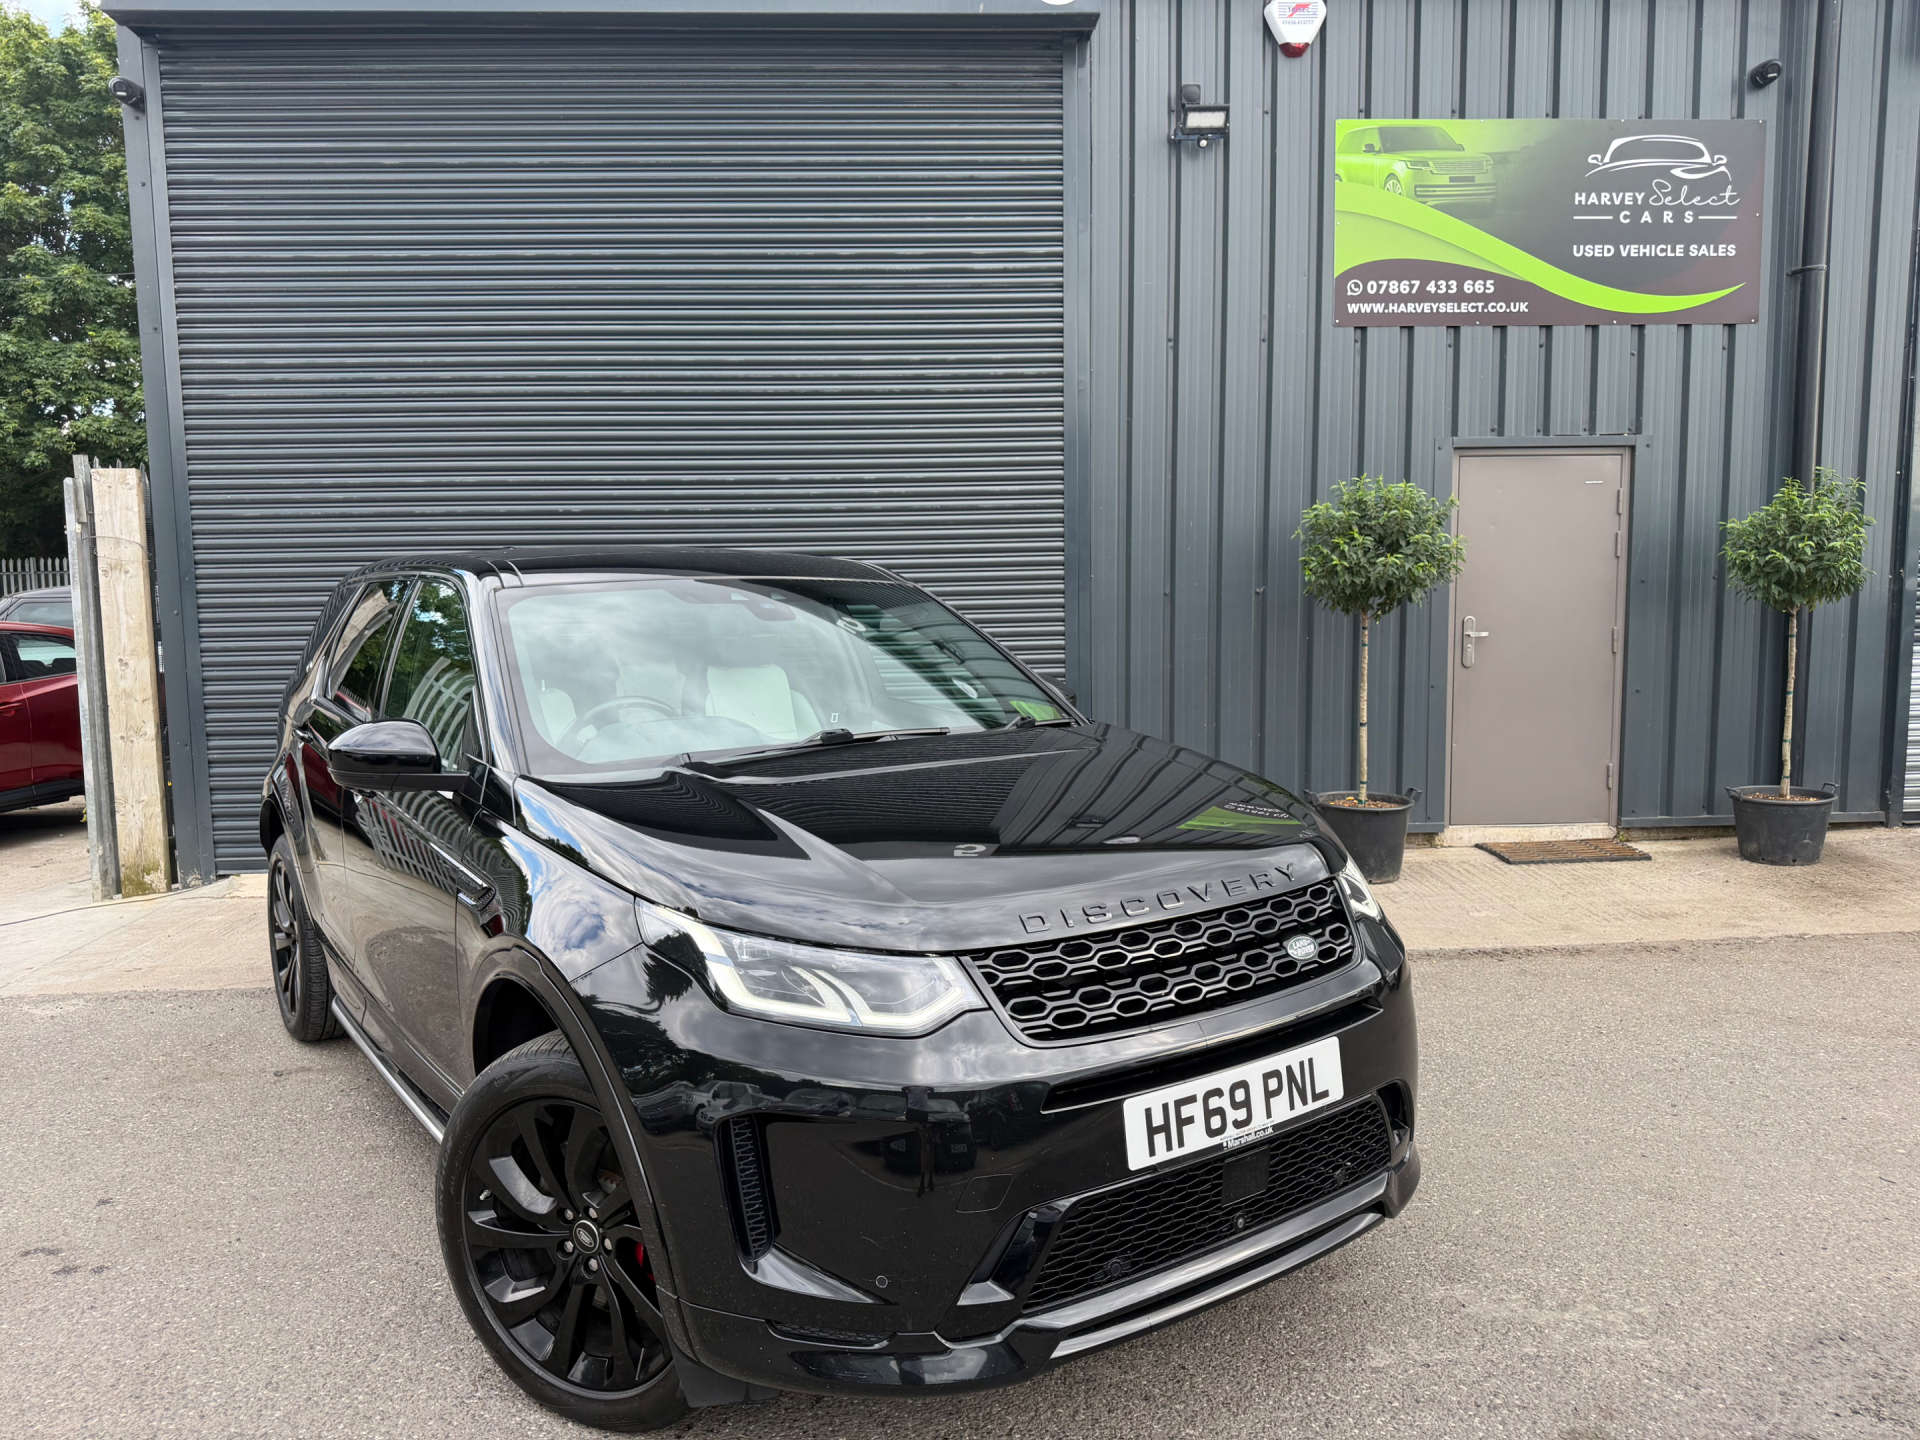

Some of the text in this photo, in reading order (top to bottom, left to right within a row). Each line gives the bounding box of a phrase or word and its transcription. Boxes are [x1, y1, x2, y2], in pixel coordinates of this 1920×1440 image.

[1574, 179, 1741, 206] HARVEY Select
[1619, 210, 1694, 224] CARS
[1573, 244, 1737, 257] USED VEHICLE SALES
[1366, 279, 1495, 295] 07867 433 665
[1347, 302, 1529, 314] WWW.HARVEYSELECT.CO.UK
[1018, 862, 1296, 934] DISCOVERY
[1144, 1057, 1330, 1157] HF69 PNL
